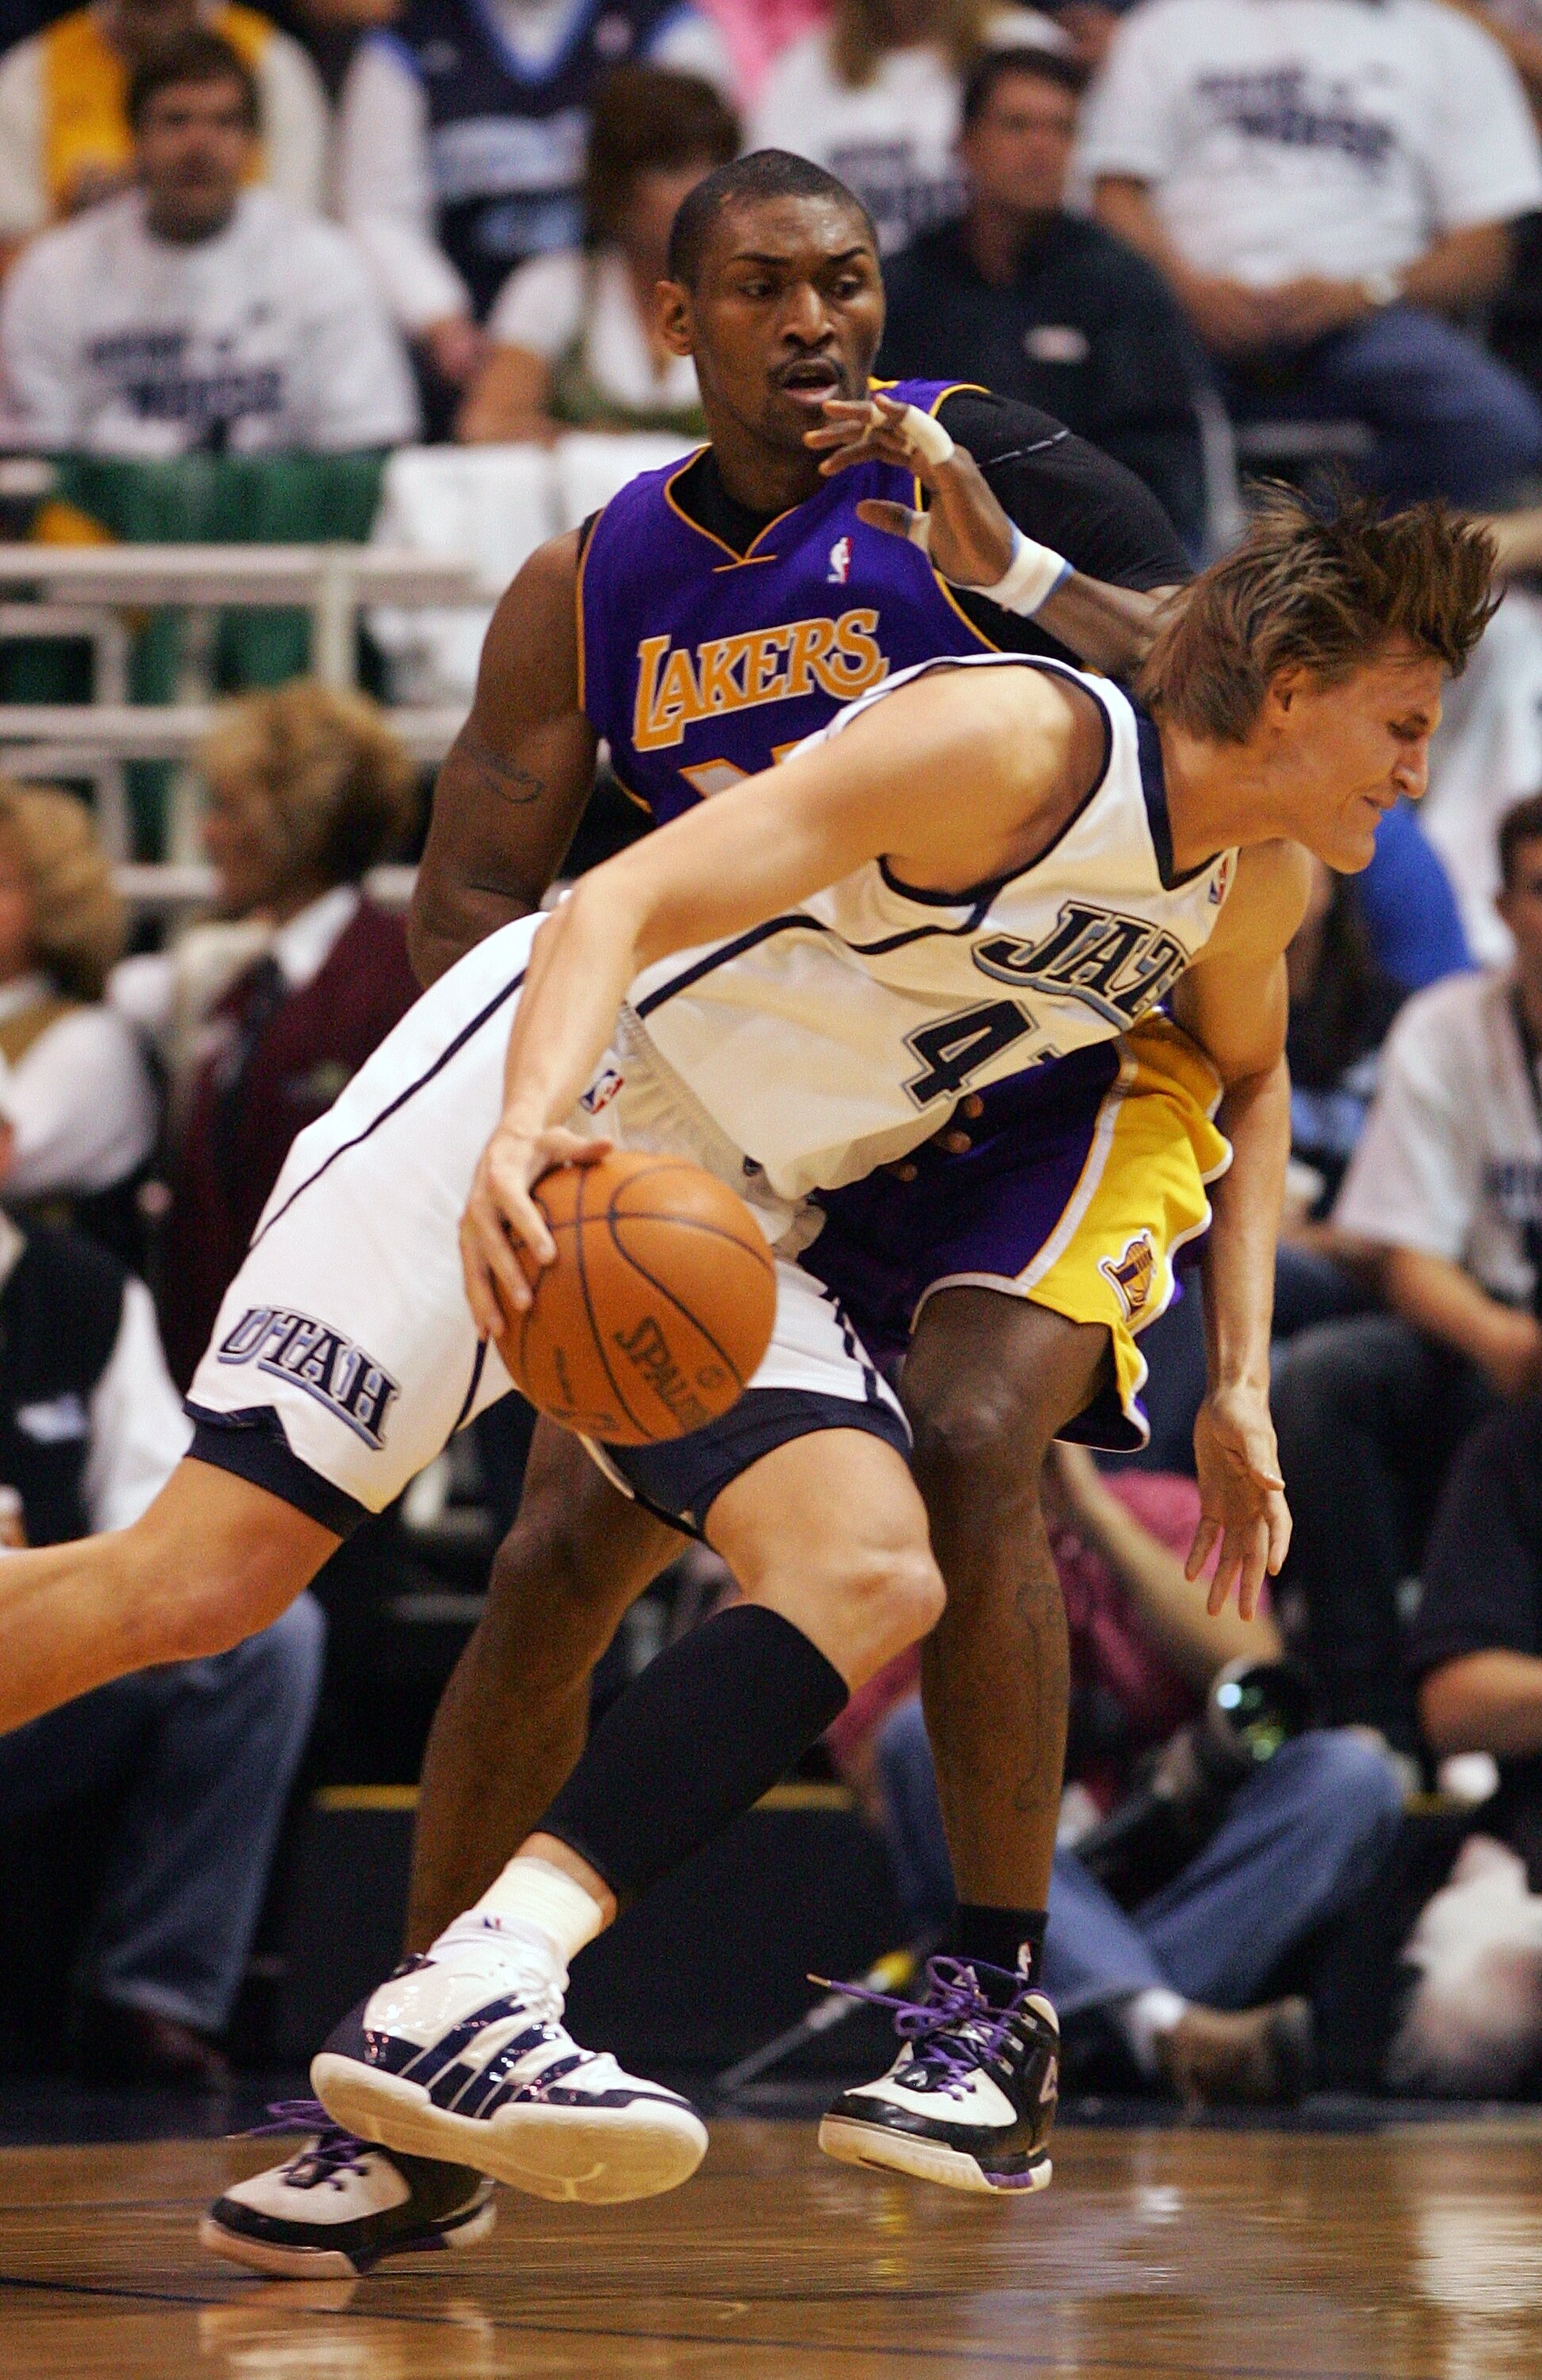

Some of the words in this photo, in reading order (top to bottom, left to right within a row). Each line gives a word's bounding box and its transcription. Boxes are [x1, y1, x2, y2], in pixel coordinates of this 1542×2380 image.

[631, 608, 890, 752] LAKERS
[971, 900, 1191, 1031] JAZ
[900, 998, 1068, 1112] 4
[217, 1305, 402, 1450] UTAH
